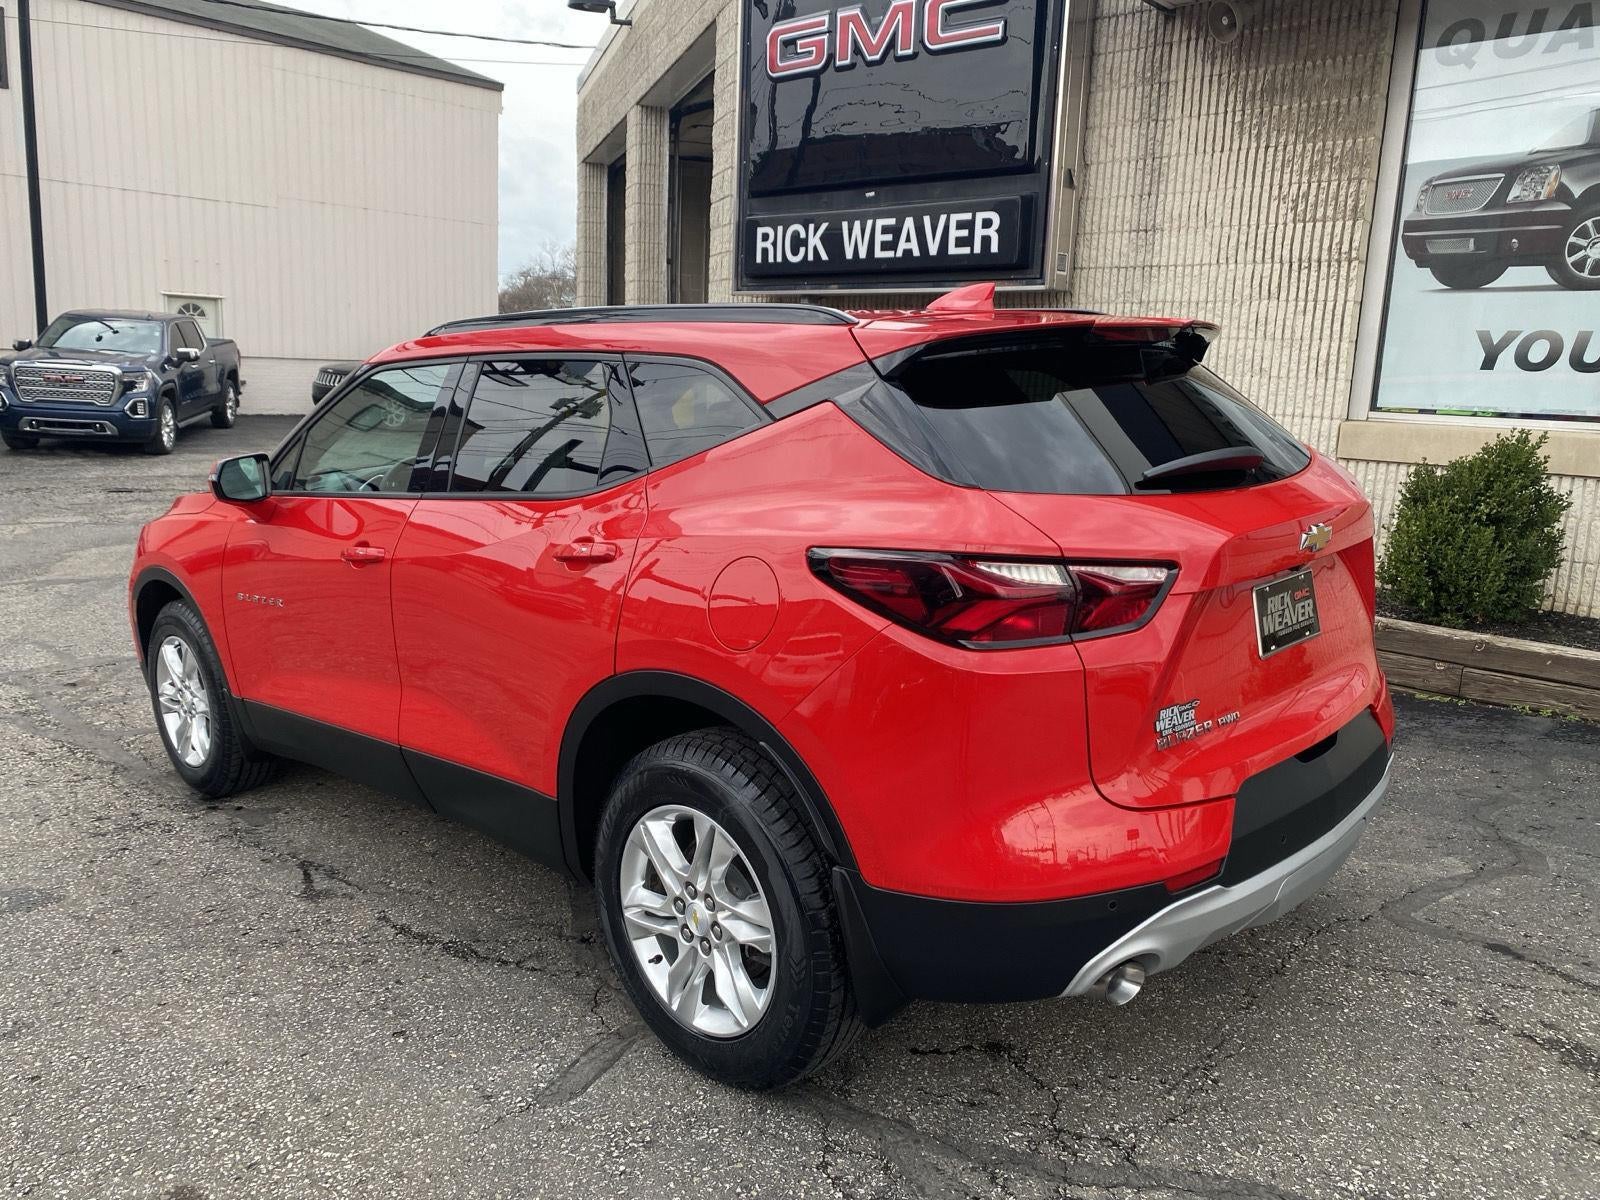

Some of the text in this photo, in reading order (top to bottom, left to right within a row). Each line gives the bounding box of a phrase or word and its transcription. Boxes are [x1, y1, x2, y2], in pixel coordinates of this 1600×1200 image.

[766, 0, 1004, 77] GMC
[1434, 2, 1594, 70] QUA
[756, 211, 1001, 263] RICK WEAVER
[236, 592, 284, 608] BLAZER
[1267, 591, 1292, 615] RICK
[1294, 588, 1310, 600] GMC
[1263, 598, 1314, 636] WEAVER
[1156, 709, 1195, 732] WEAVER
[1160, 705, 1181, 720] RICK
